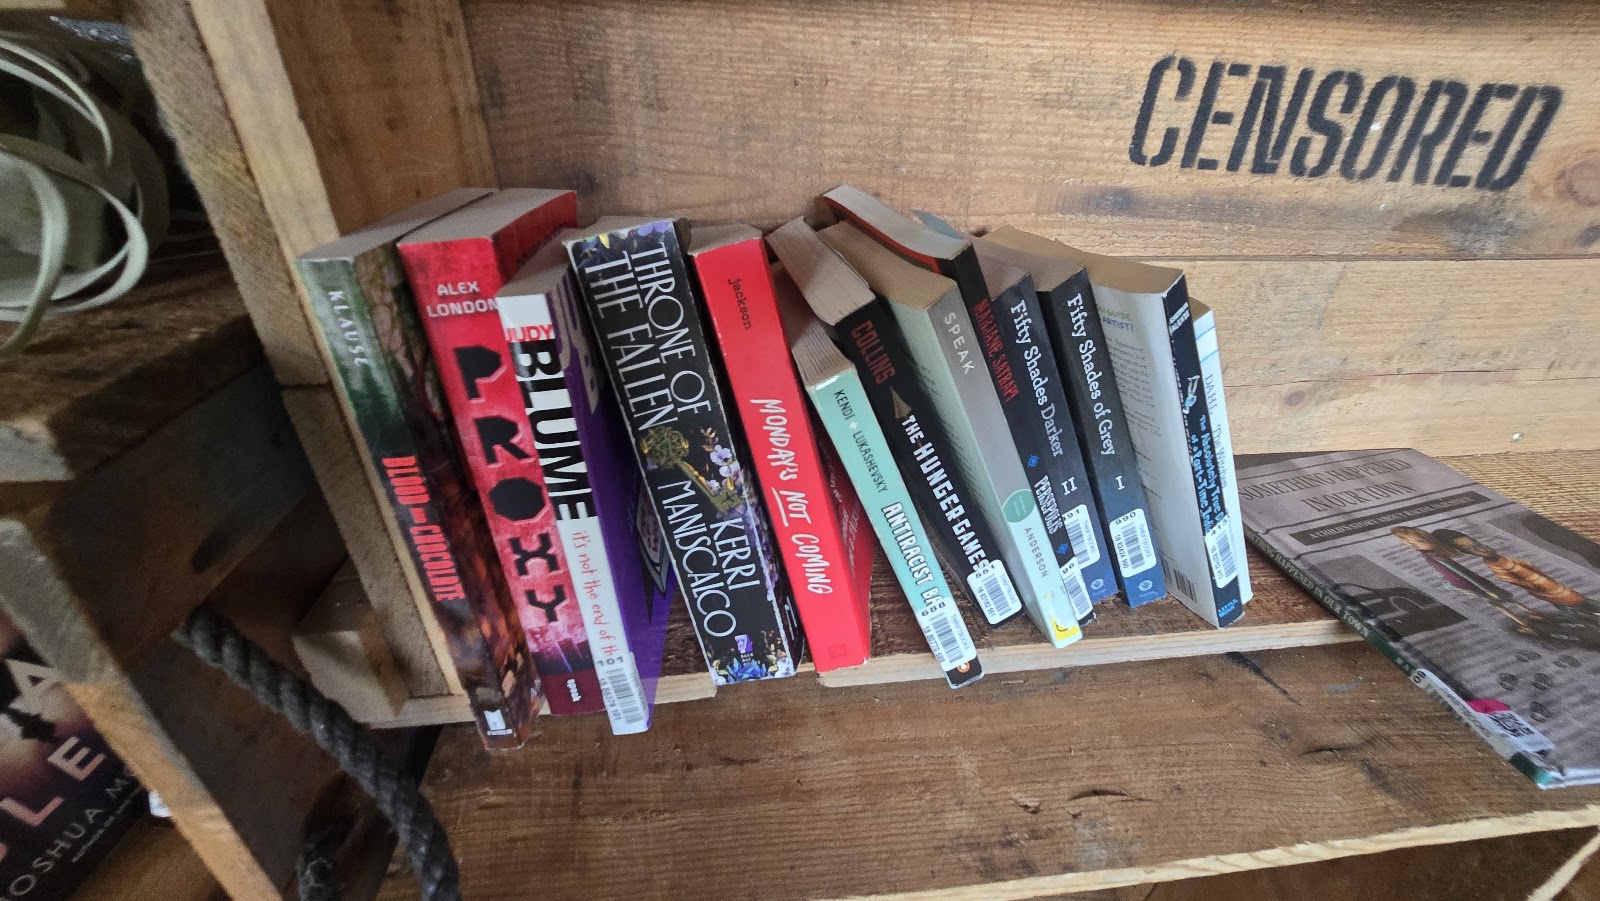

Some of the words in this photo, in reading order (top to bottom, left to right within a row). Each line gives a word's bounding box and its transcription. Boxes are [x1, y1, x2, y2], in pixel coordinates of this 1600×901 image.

[1128, 55, 1564, 191] CENSORED
[426, 297, 498, 318] LONDON
[437, 280, 480, 297] ALEX
[584, 250, 644, 319] THE
[728, 277, 752, 331] jackson
[328, 290, 370, 366] KLAUSE
[505, 323, 553, 342] JUDY
[631, 242, 697, 364] THRONE
[670, 369, 712, 414] OF
[943, 311, 976, 375] SPEAK
[1067, 293, 1089, 338] Fifty
[607, 322, 679, 431] FALLEN
[851, 320, 896, 385] COLLINS
[972, 298, 1004, 358] MARJANE
[992, 354, 1020, 403] SATRAPI
[1011, 299, 1031, 345] Fifty
[1024, 345, 1049, 406] Shades
[1041, 402, 1064, 458] Darker
[1079, 338, 1103, 400] Shades
[1093, 402, 1112, 421] of
[1205, 373, 1219, 416] DAHL
[509, 338, 598, 521] BLUME
[833, 388, 854, 422] KENDI
[852, 430, 888, 493] LUKASHEVSKY
[902, 414, 925, 444] THE
[1098, 419, 1116, 456] Grey
[453, 345, 568, 623] PROXY
[750, 398, 799, 481] MONDAY'S
[791, 533, 833, 595] COMING
[913, 442, 965, 522] HUNGER
[1201, 432, 1218, 489] Absolutely
[1211, 486, 1221, 514] True
[1237, 473, 1334, 501] SOMETHING
[1331, 458, 1413, 482] HAPPENED
[1301, 497, 1334, 512] IN
[1323, 488, 1371, 508] OUR
[1362, 480, 1417, 501] TOWN
[1034, 475, 1064, 535] PERSEPOLIS
[1115, 511, 1136, 526] 990
[409, 524, 466, 601] CHOCOLATE
[572, 530, 592, 549] it's
[578, 553, 598, 575] not
[657, 480, 738, 637] MANISCALCO
[710, 517, 760, 591] KERRI
[881, 501, 935, 586] ANTIRACIST
[952, 517, 990, 573] GAMES
[1024, 527, 1049, 578] ANDERSON
[584, 579, 601, 600] the
[591, 603, 610, 626] end
[921, 601, 946, 616] 688
[1274, 551, 1315, 590] HAPPENED
[1313, 587, 1324, 599] IN
[1323, 597, 1342, 614] OUR
[1342, 609, 1370, 637] TOWN
[597, 655, 624, 667] 101
[599, 628, 616, 641] of
[0, 808, 104, 901] OSHUA
